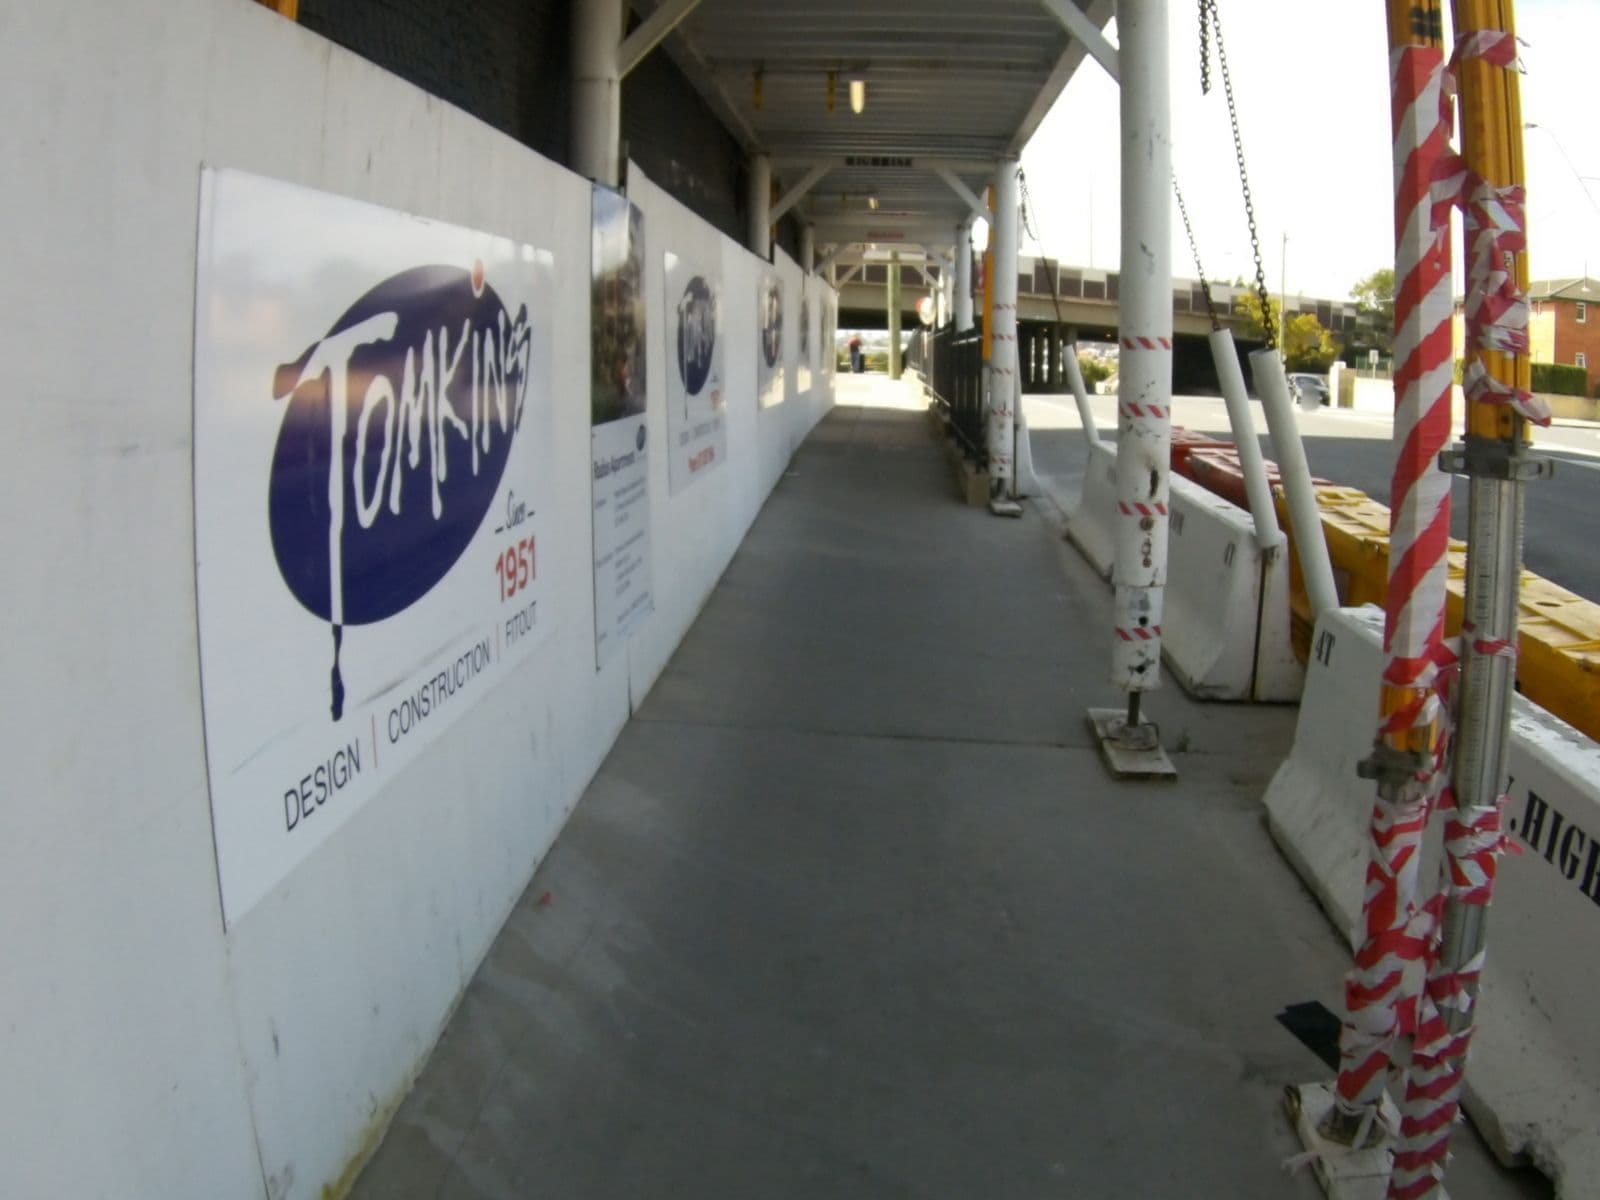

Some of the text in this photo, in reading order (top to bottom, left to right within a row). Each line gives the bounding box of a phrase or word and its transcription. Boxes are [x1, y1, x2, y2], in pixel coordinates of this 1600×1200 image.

[272, 302, 532, 721] TOMKINS
[495, 534, 536, 602] 1951
[284, 738, 361, 832] DESIGN
[388, 636, 491, 745] CONSTRUCTION
[505, 600, 537, 649] FITOUT
